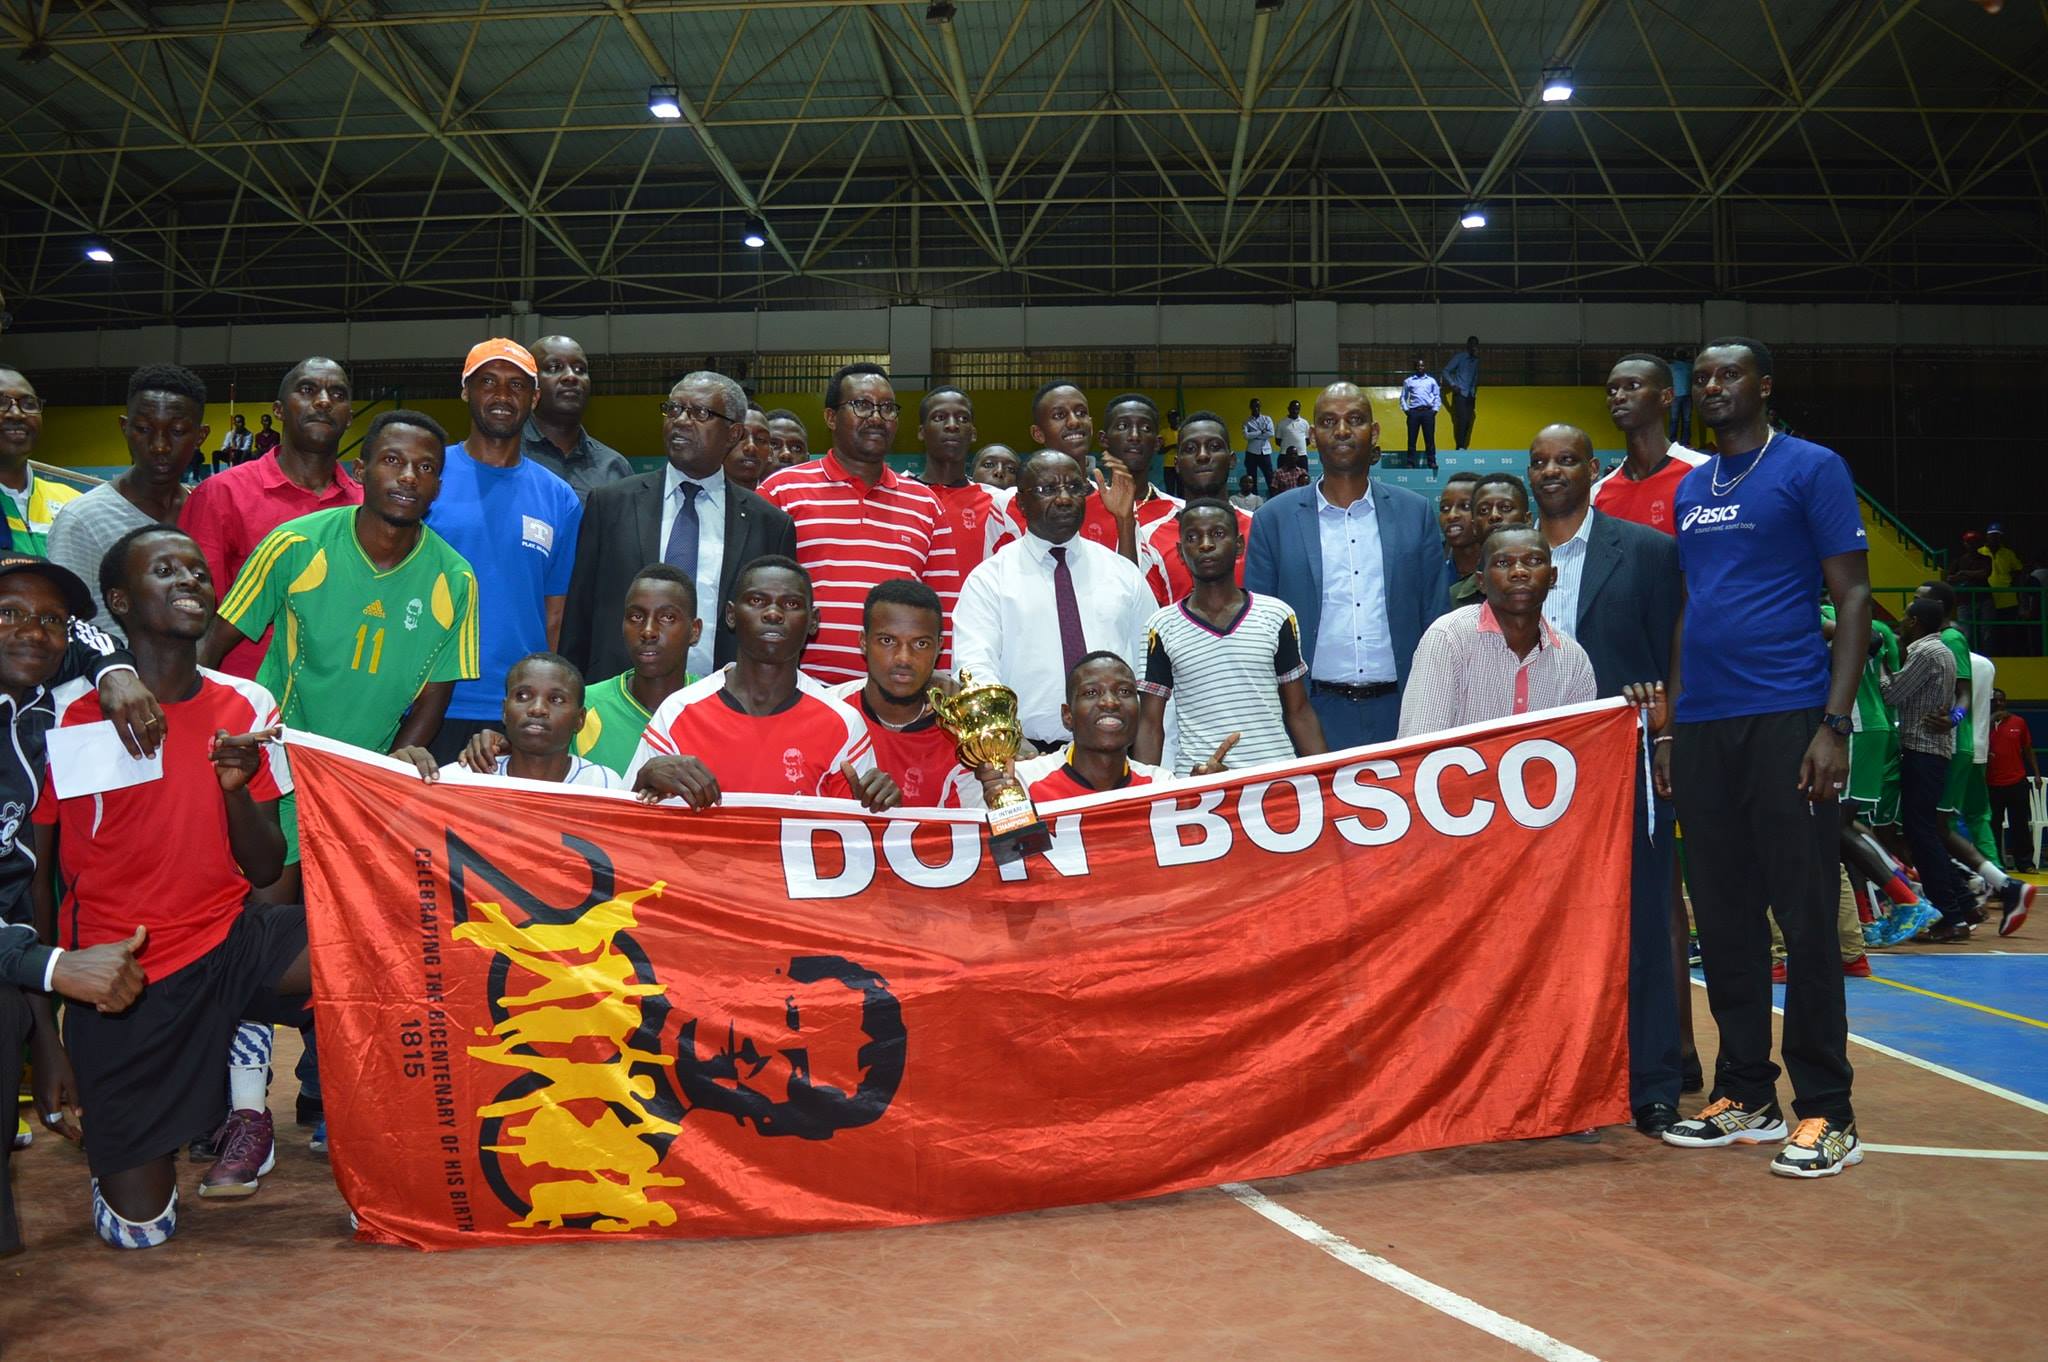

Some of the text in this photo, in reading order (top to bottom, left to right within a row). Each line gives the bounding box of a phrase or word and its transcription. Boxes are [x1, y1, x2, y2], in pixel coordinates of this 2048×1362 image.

[1697, 504, 1741, 524] asics
[351, 623, 385, 674] 11
[1149, 738, 1577, 868] BOSCO
[401, 1018, 425, 1079] 1815
[415, 847, 476, 1233] CELEBRATING THE BICENTENARY OF HIS BIRTH
